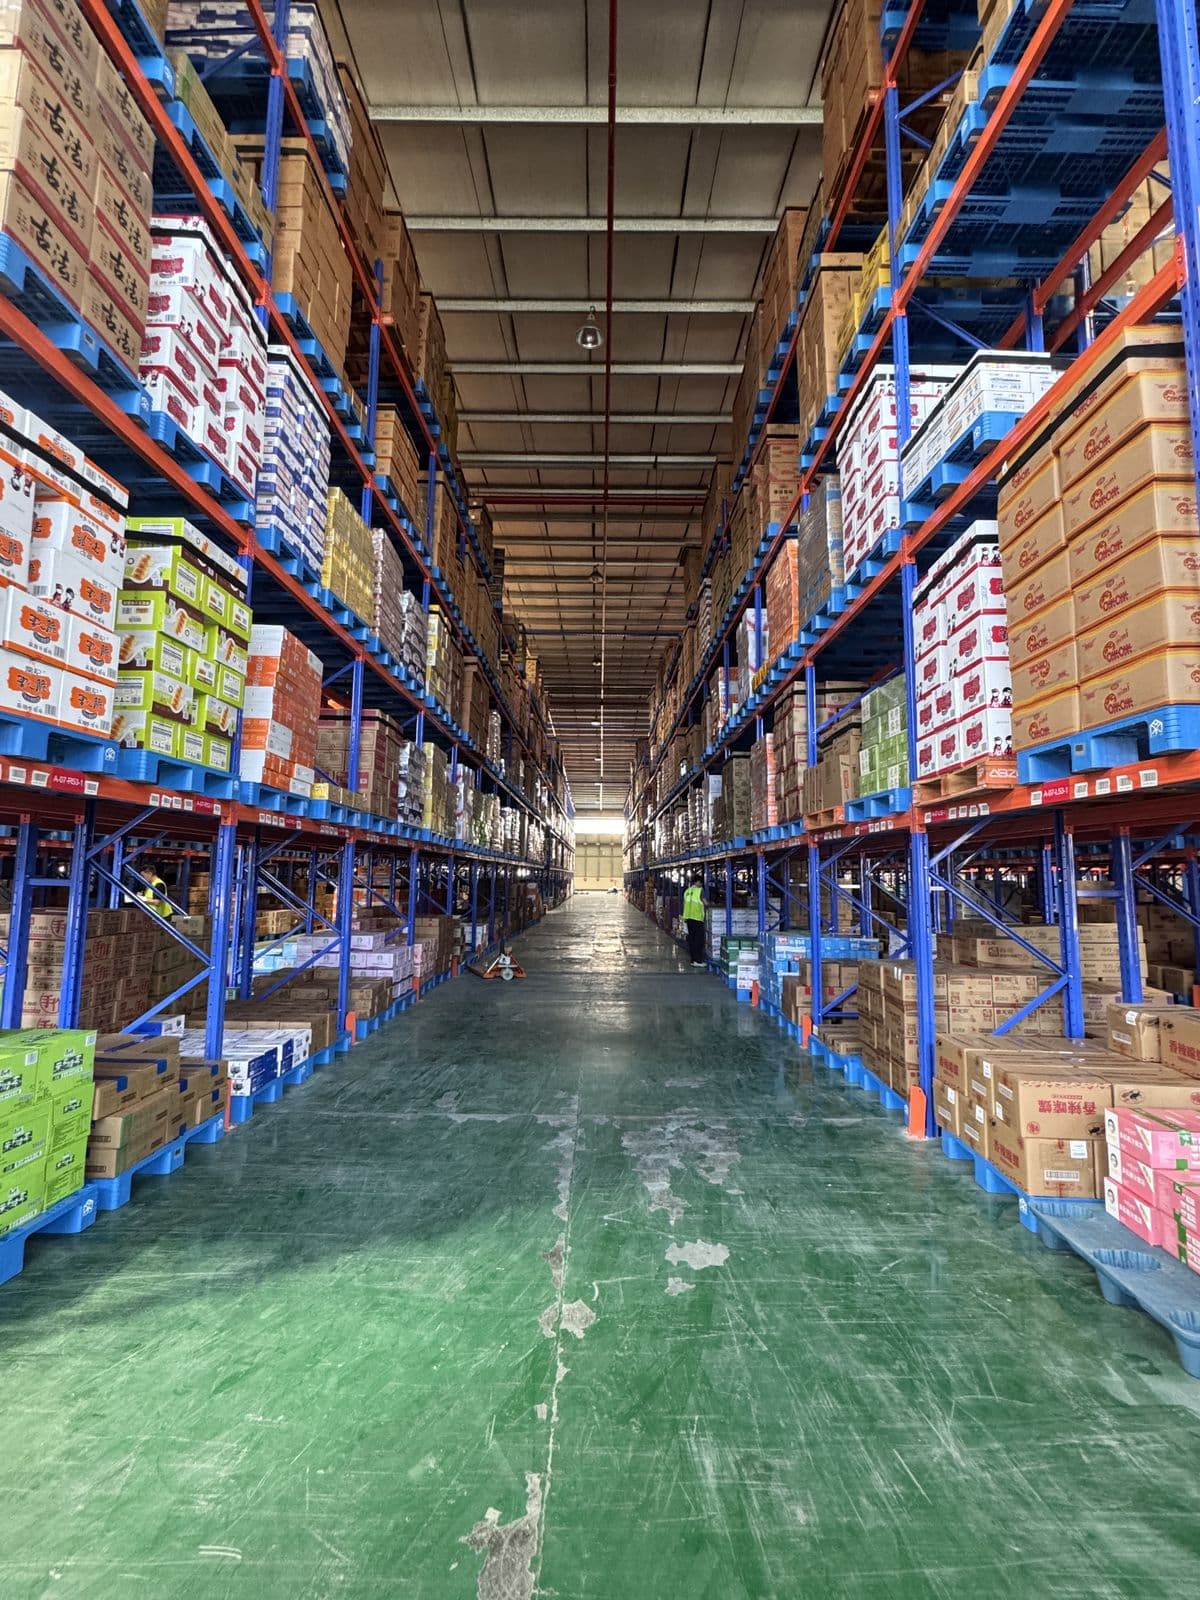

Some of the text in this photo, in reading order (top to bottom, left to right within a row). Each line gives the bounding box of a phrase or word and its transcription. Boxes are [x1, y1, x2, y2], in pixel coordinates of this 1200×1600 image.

[42, 33, 84, 112] 古法
[44, 97, 83, 172] 古法
[40, 153, 79, 224] 古法
[29, 215, 71, 283] 古法
[113, 199, 143, 257] 古法
[109, 250, 139, 307] 古法
[101, 302, 132, 357] 古法
